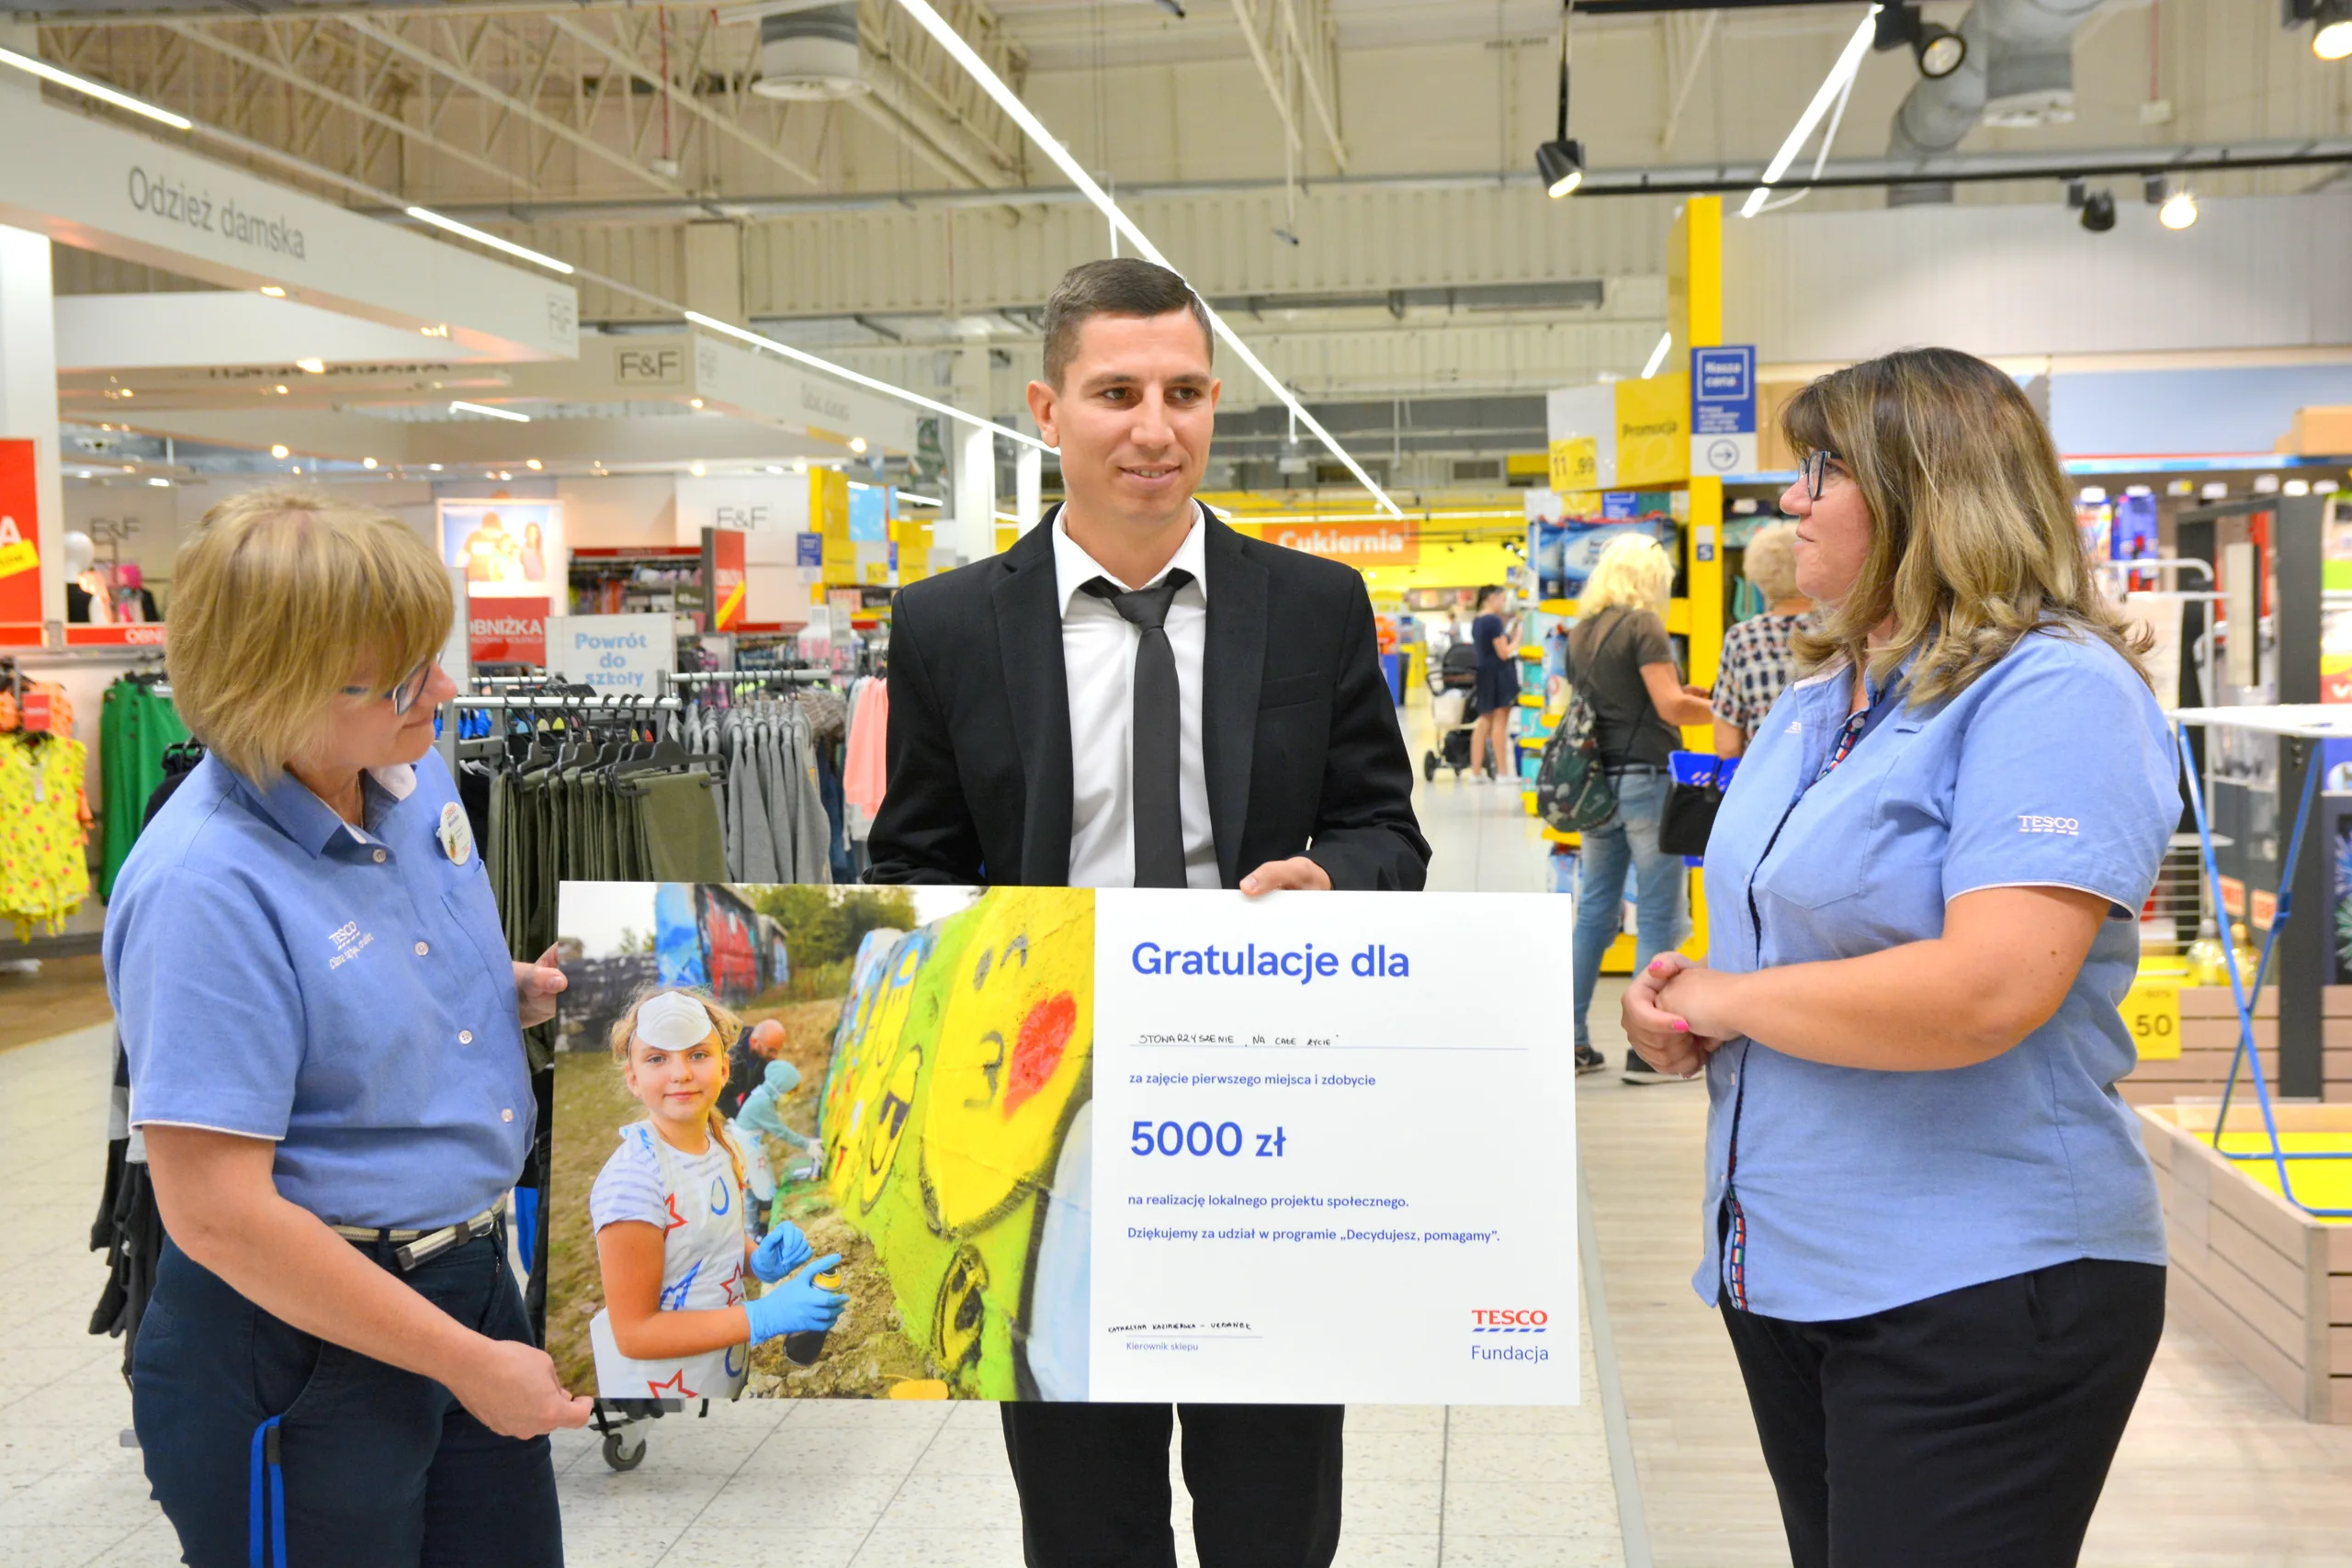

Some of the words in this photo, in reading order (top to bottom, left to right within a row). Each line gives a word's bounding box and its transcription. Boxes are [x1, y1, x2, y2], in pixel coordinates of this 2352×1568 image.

[129, 165, 215, 232] Odzież
[220, 197, 306, 262] damska
[620, 351, 677, 379] F&F
[717, 505, 769, 531] F&F
[1278, 528, 1404, 553] Cukiernia
[574, 631, 647, 649] Powrót
[599, 652, 627, 669] do
[584, 672, 643, 687] szkoły
[2017, 815, 2080, 831] TESCO
[328, 920, 357, 946] TESCO
[1131, 941, 1340, 986] Gratulacje
[1351, 943, 1409, 978] dla
[1129, 1075, 1143, 1084] za
[1146, 1072, 1190, 1087] zajęcie
[1192, 1073, 1261, 1088] pierwszego
[1264, 1073, 1312, 1088] miejsca
[1315, 1074, 1318, 1085] i
[1321, 1074, 1376, 1089] zdobycie
[1130, 1120, 1243, 1157] 5000
[1255, 1125, 1287, 1158] zł
[1128, 1196, 1144, 1205] na
[1146, 1193, 1205, 1209] realizację
[1208, 1194, 1268, 1209] lokalnego
[1271, 1194, 1324, 1209] projektu
[1327, 1195, 1409, 1210] społecznego.
[1127, 1226, 1199, 1242] Dziękujemy
[1201, 1230, 1216, 1239] za
[1217, 1227, 1256, 1239] udział
[1259, 1230, 1270, 1239] w
[1272, 1228, 1337, 1243] programie
[1472, 1309, 1548, 1325] TESCO
[1126, 1342, 1169, 1350] Kierownik
[1170, 1342, 1199, 1352] sklepu
[1471, 1345, 1549, 1364] Fundacja
